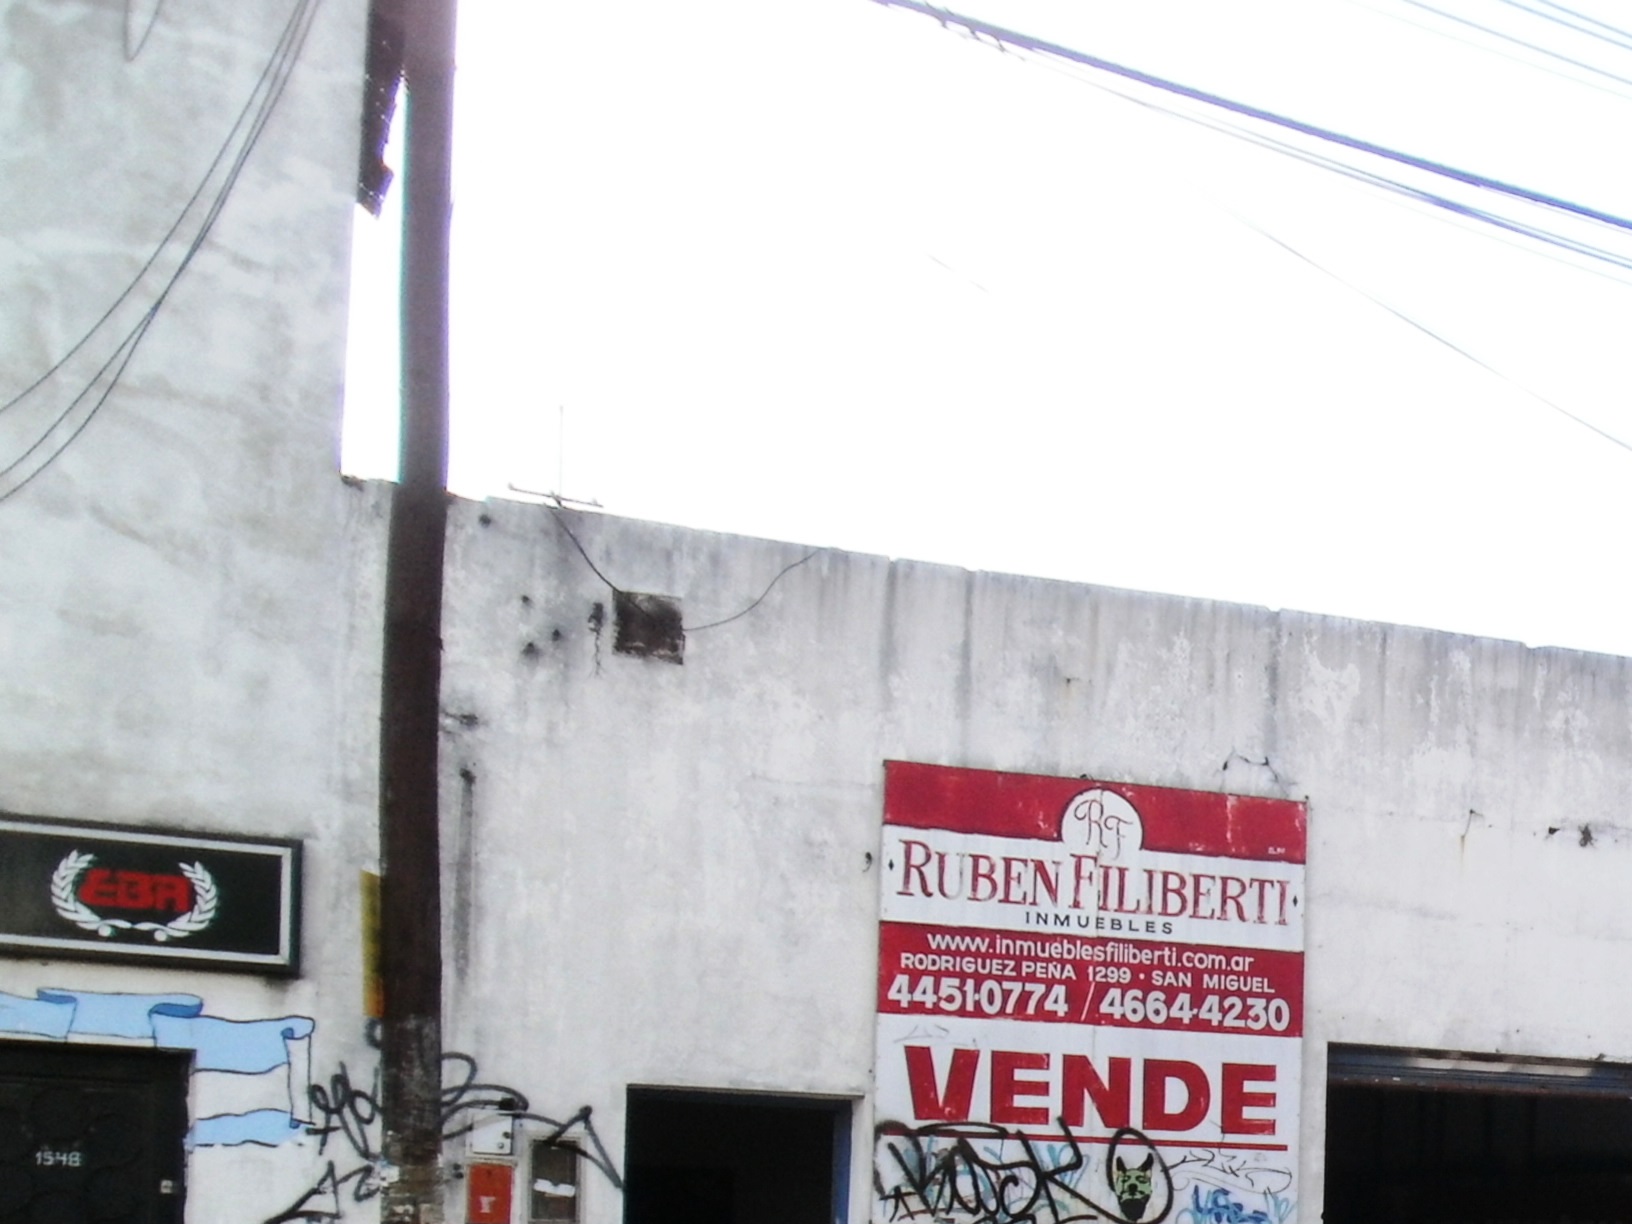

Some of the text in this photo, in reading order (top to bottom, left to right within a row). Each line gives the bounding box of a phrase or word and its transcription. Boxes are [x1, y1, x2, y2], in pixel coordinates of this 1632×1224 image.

[896, 839, 1290, 926] RUBEN FILIBERTI
[1025, 911, 1173, 935] INMUEBLES
[926, 933, 1254, 972] www.inmueblesfiliberti.com.ar
[900, 952, 1276, 994] RODRIGUEZ PEÑA 1299 SAN MIGUEL
[904, 1045, 1277, 1136] VENDE
[35, 1151, 82, 1167] 1548
